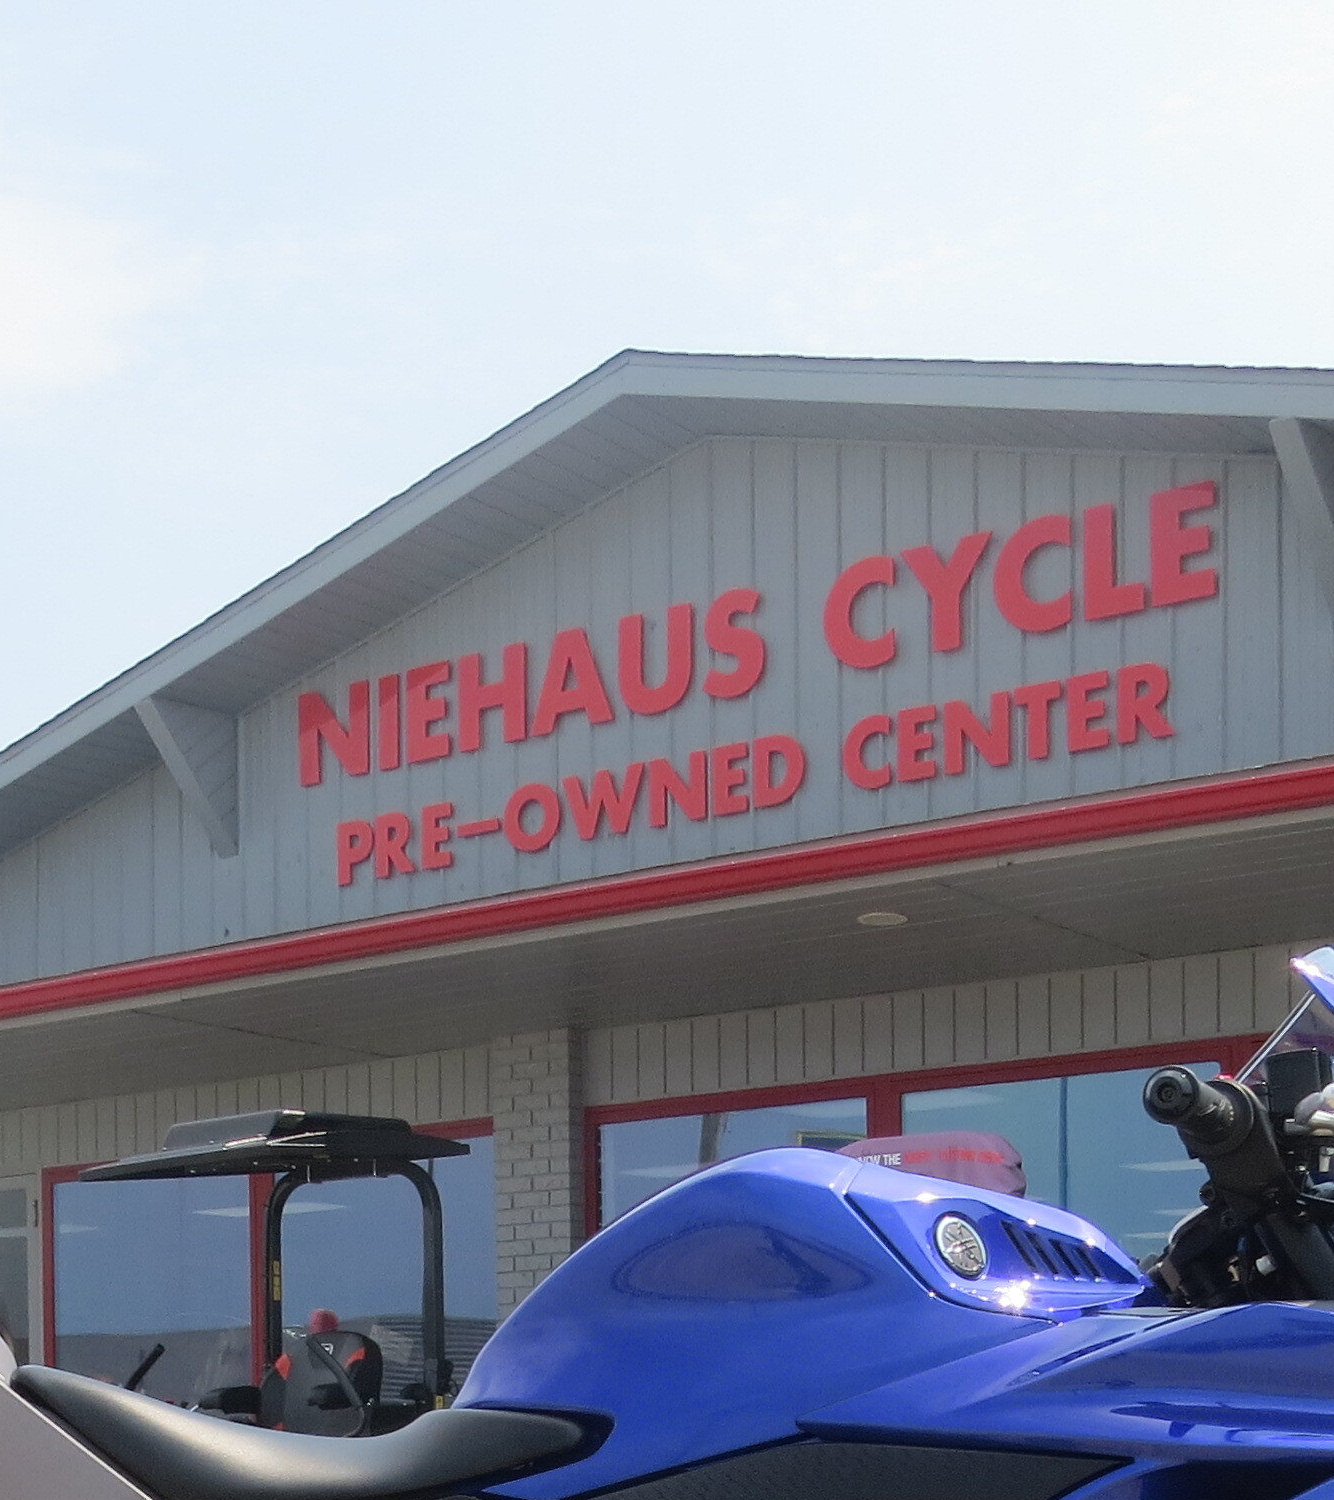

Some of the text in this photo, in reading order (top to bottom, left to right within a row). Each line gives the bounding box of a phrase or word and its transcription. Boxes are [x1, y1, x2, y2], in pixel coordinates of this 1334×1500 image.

[298, 481, 1220, 786] NIEHAUS CYCLE
[336, 663, 1175, 886] PRE-OWNED CENTER
[883, 1153, 902, 1166] THE
